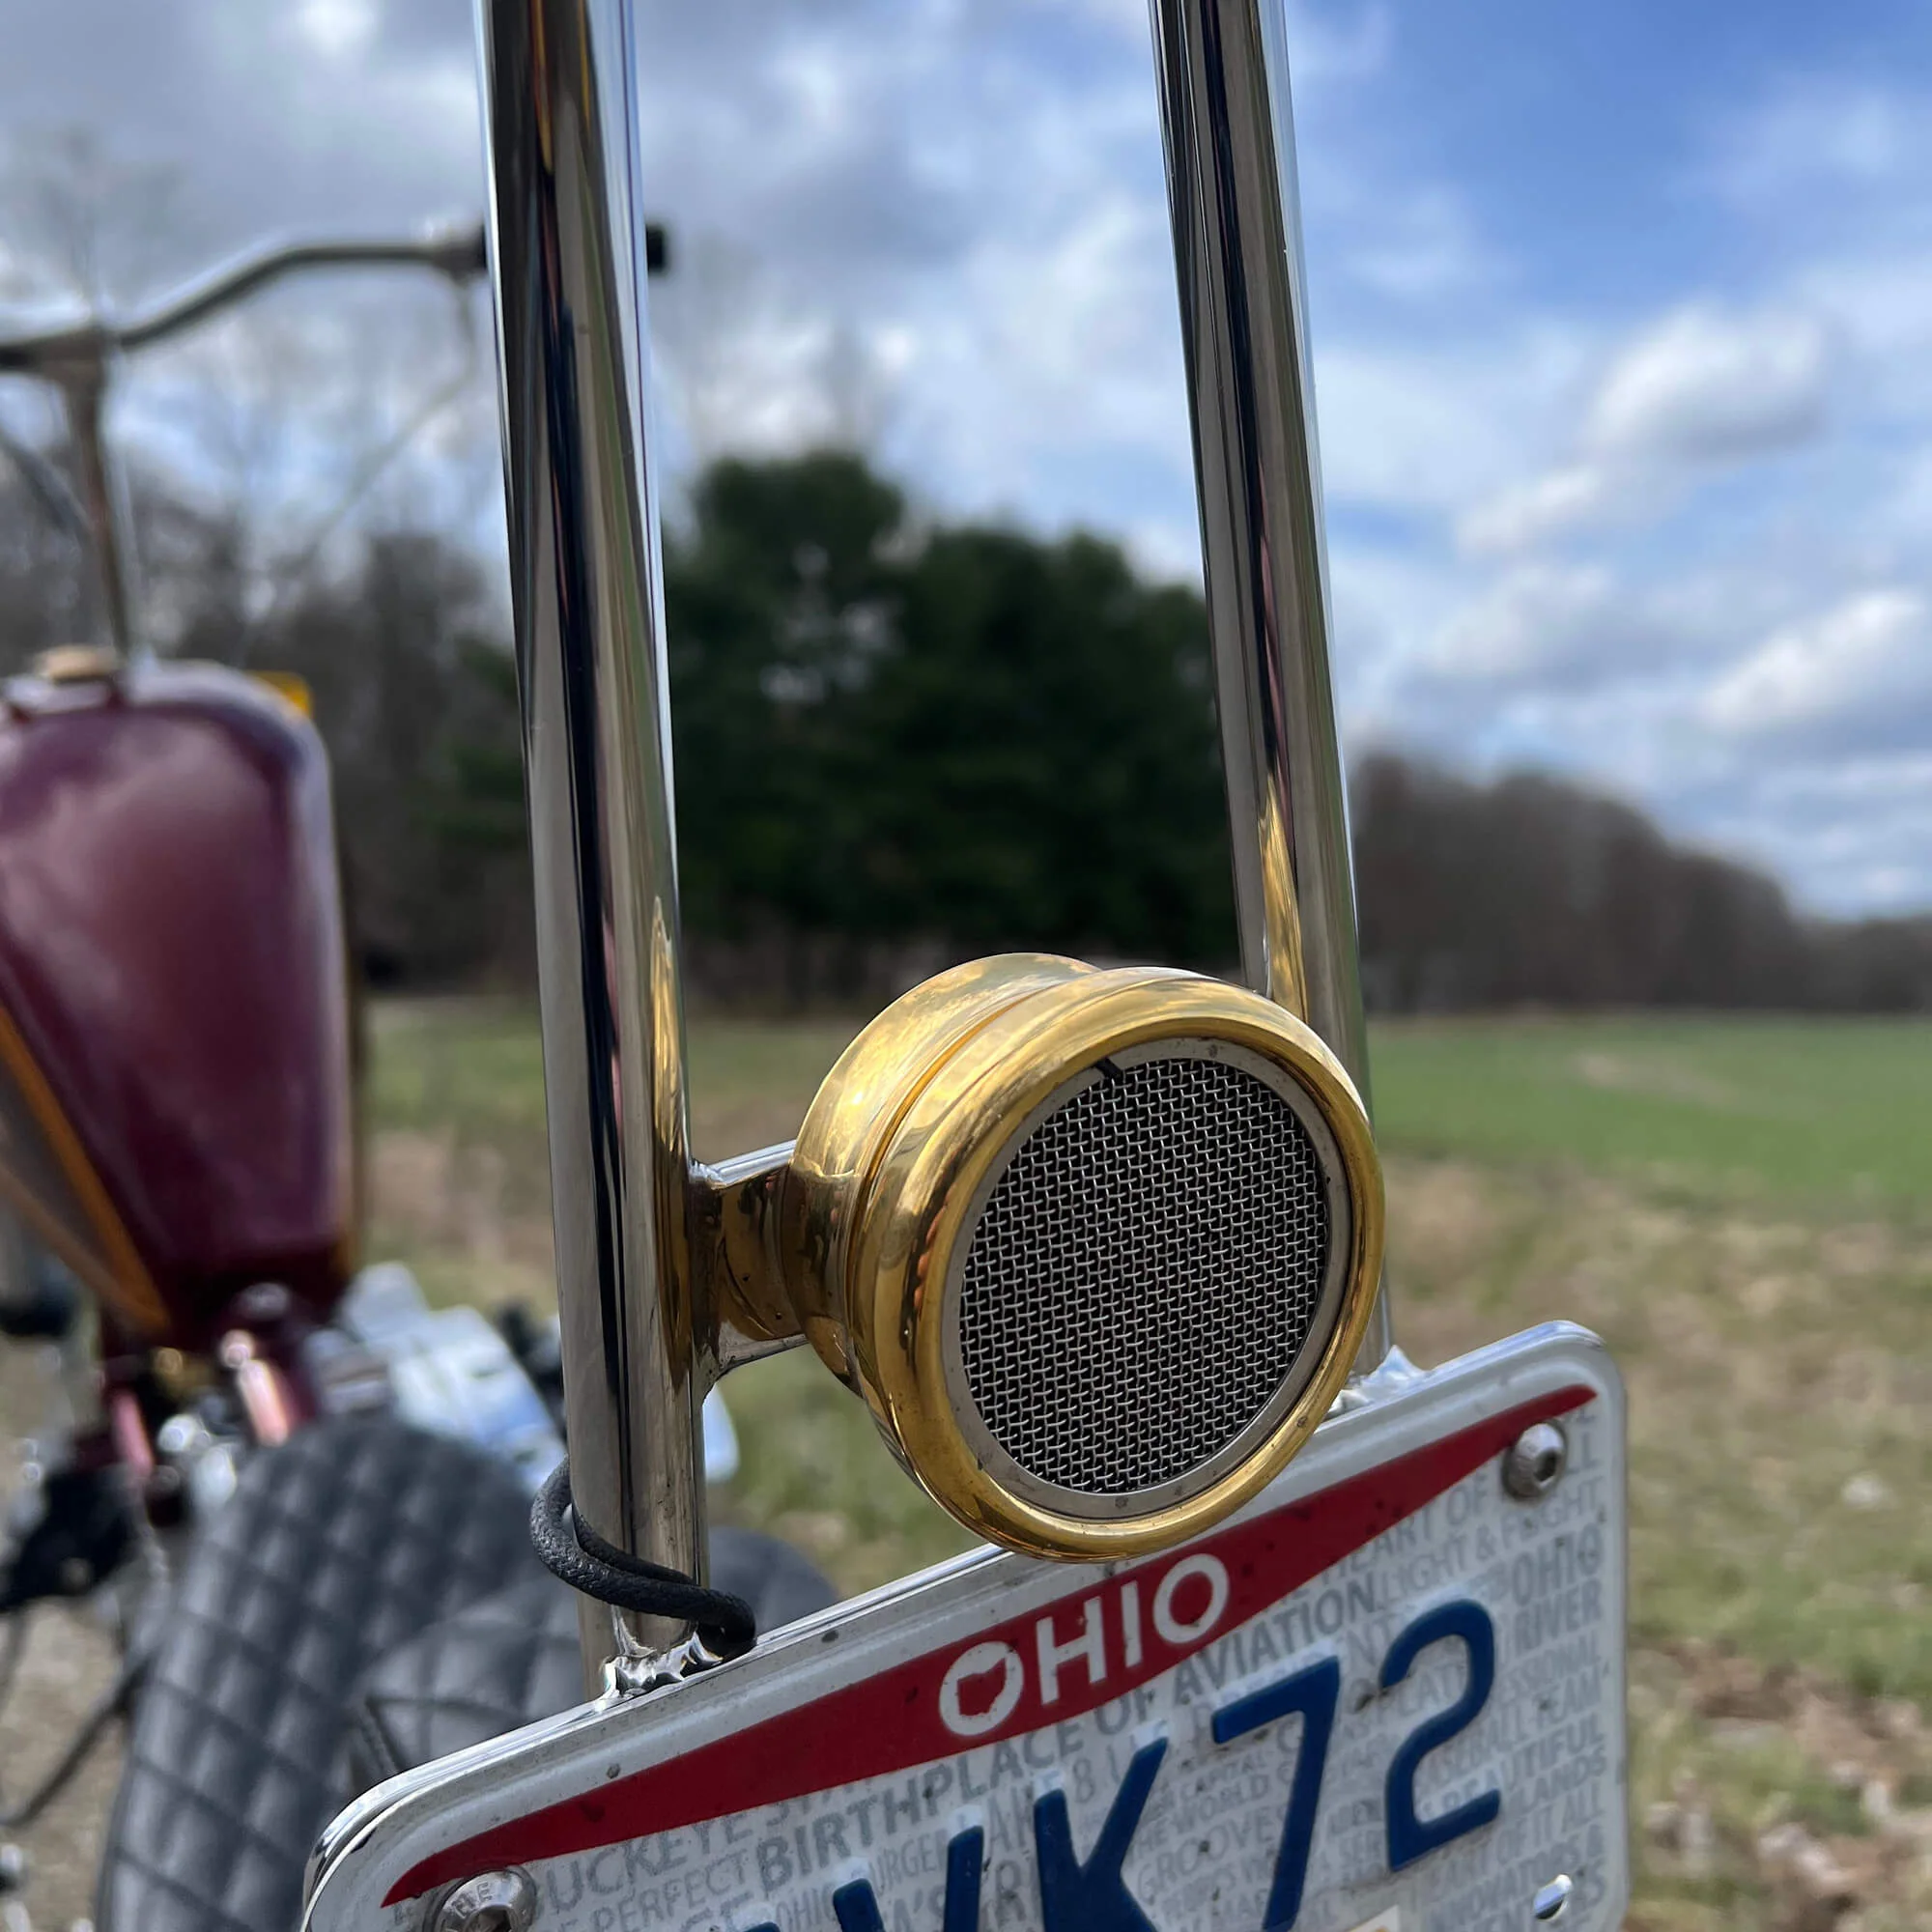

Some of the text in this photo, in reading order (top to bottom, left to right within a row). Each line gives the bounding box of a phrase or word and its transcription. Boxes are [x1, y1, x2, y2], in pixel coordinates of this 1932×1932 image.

[1512, 1521, 1604, 1607] OHIO
[939, 1553, 1229, 1736] OHIO
[1514, 1578, 1605, 1658] RIVER
[756, 1720, 1084, 1895] BIRTHPLACE
[1172, 1563, 1376, 1706] AVIATION
[544, 1819, 753, 1913] UCKEYE
